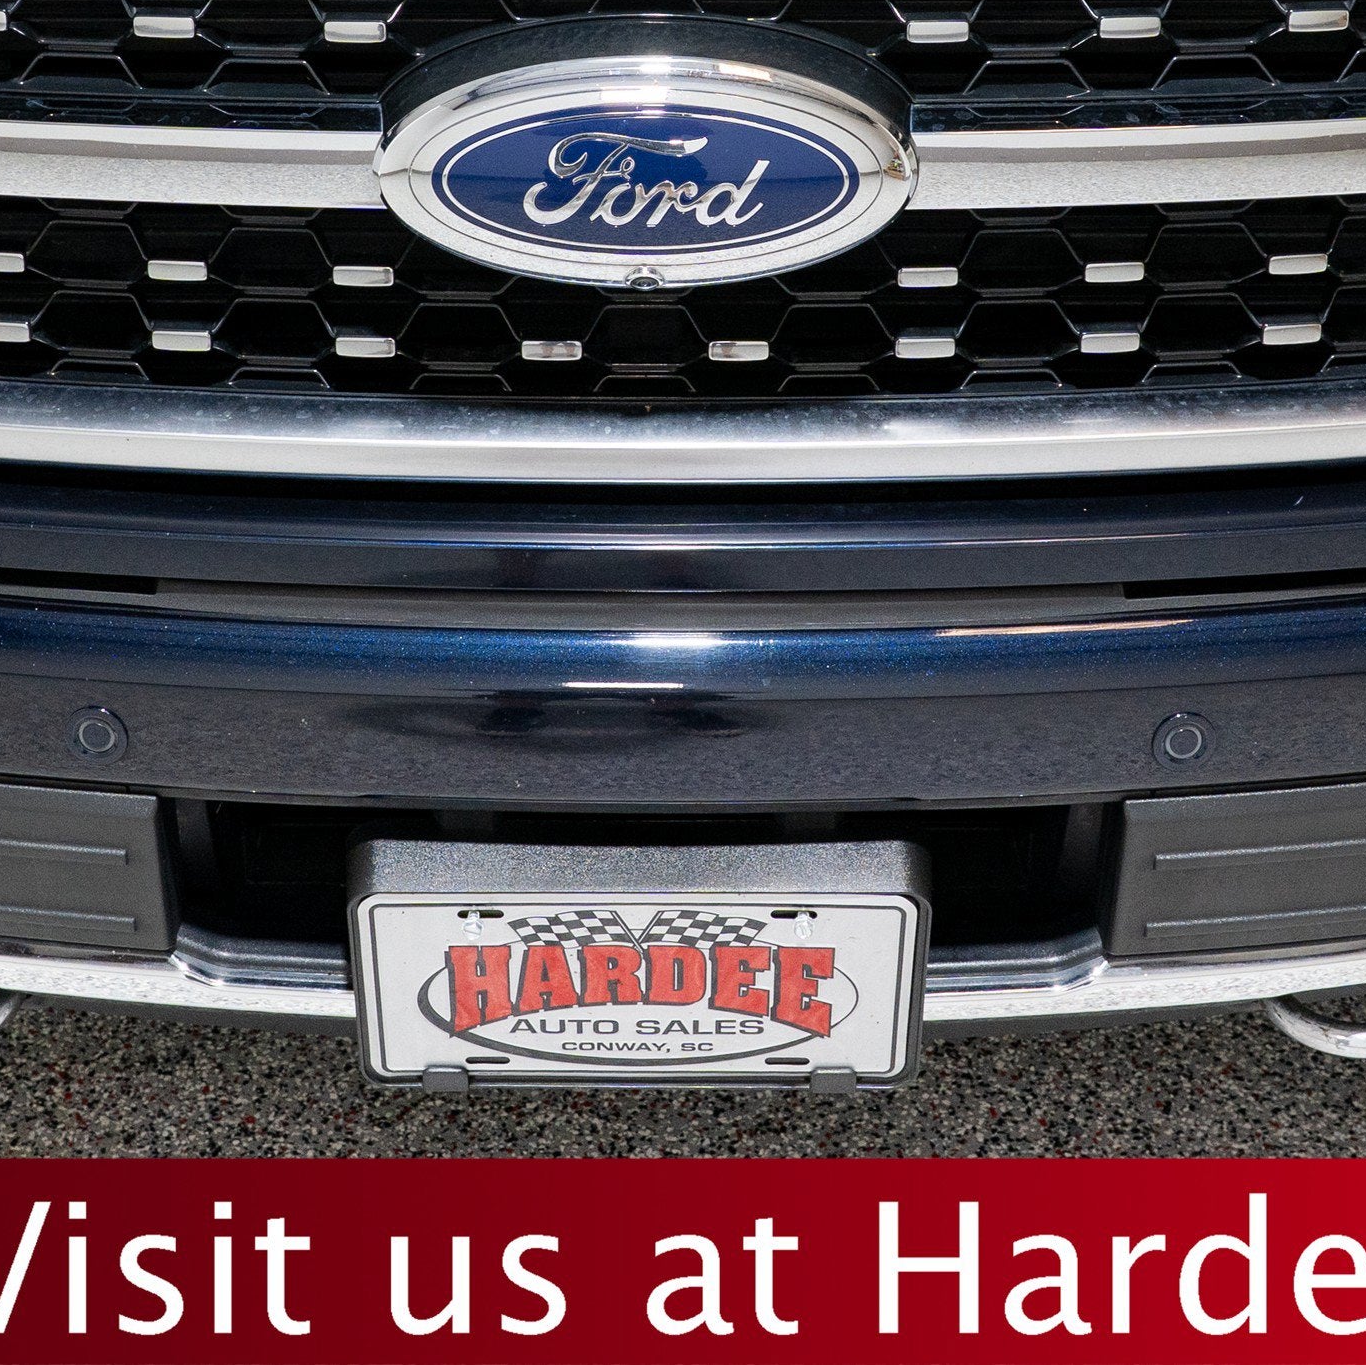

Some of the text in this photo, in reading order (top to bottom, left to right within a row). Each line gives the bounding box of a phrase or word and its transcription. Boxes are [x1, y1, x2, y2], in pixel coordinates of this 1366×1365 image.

[522, 132, 770, 228] Ford
[444, 945, 836, 1039] HARDEE
[510, 1019, 765, 1036] AUTO SALES
[561, 1041, 715, 1054] CONWAY, SC
